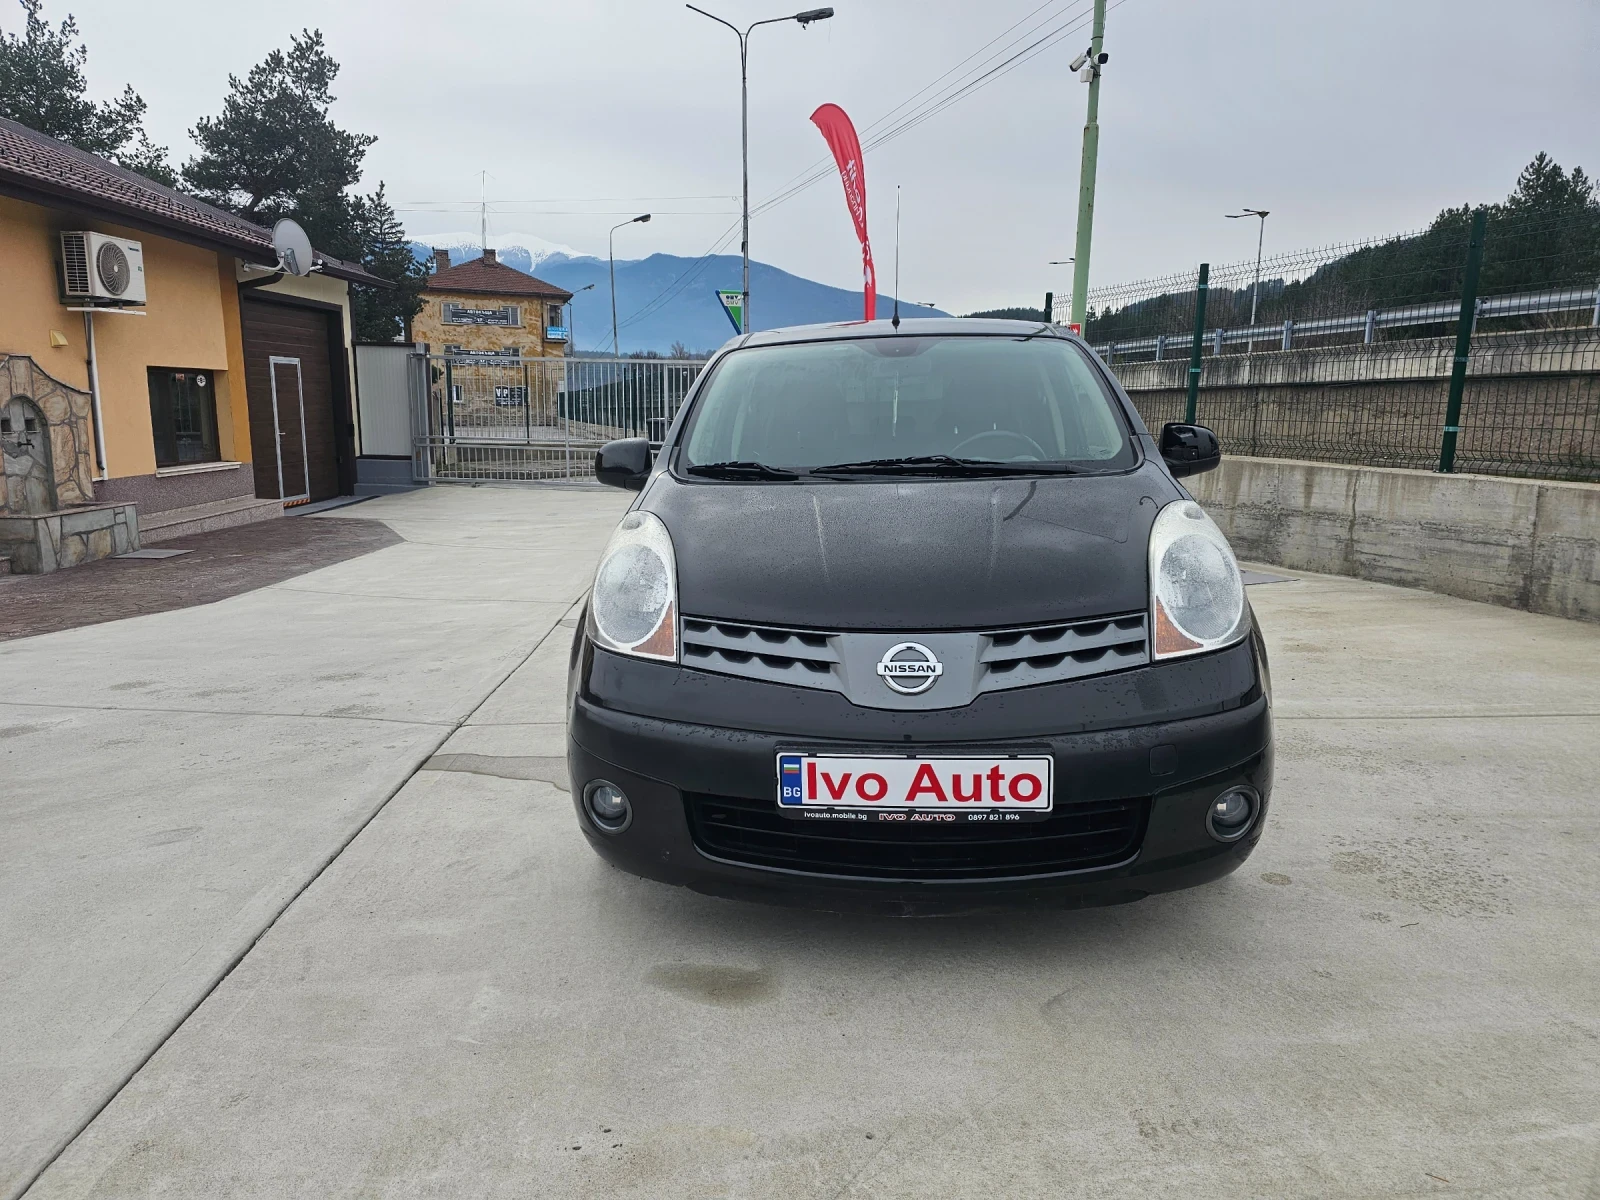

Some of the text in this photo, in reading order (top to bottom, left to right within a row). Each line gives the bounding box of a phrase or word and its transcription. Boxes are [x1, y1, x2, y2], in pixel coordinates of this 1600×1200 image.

[883, 664, 936, 673] NISSAN
[806, 762, 1042, 803] Ivo Auto
[783, 786, 801, 798] BG
[878, 813, 956, 822] IVO AUTO
